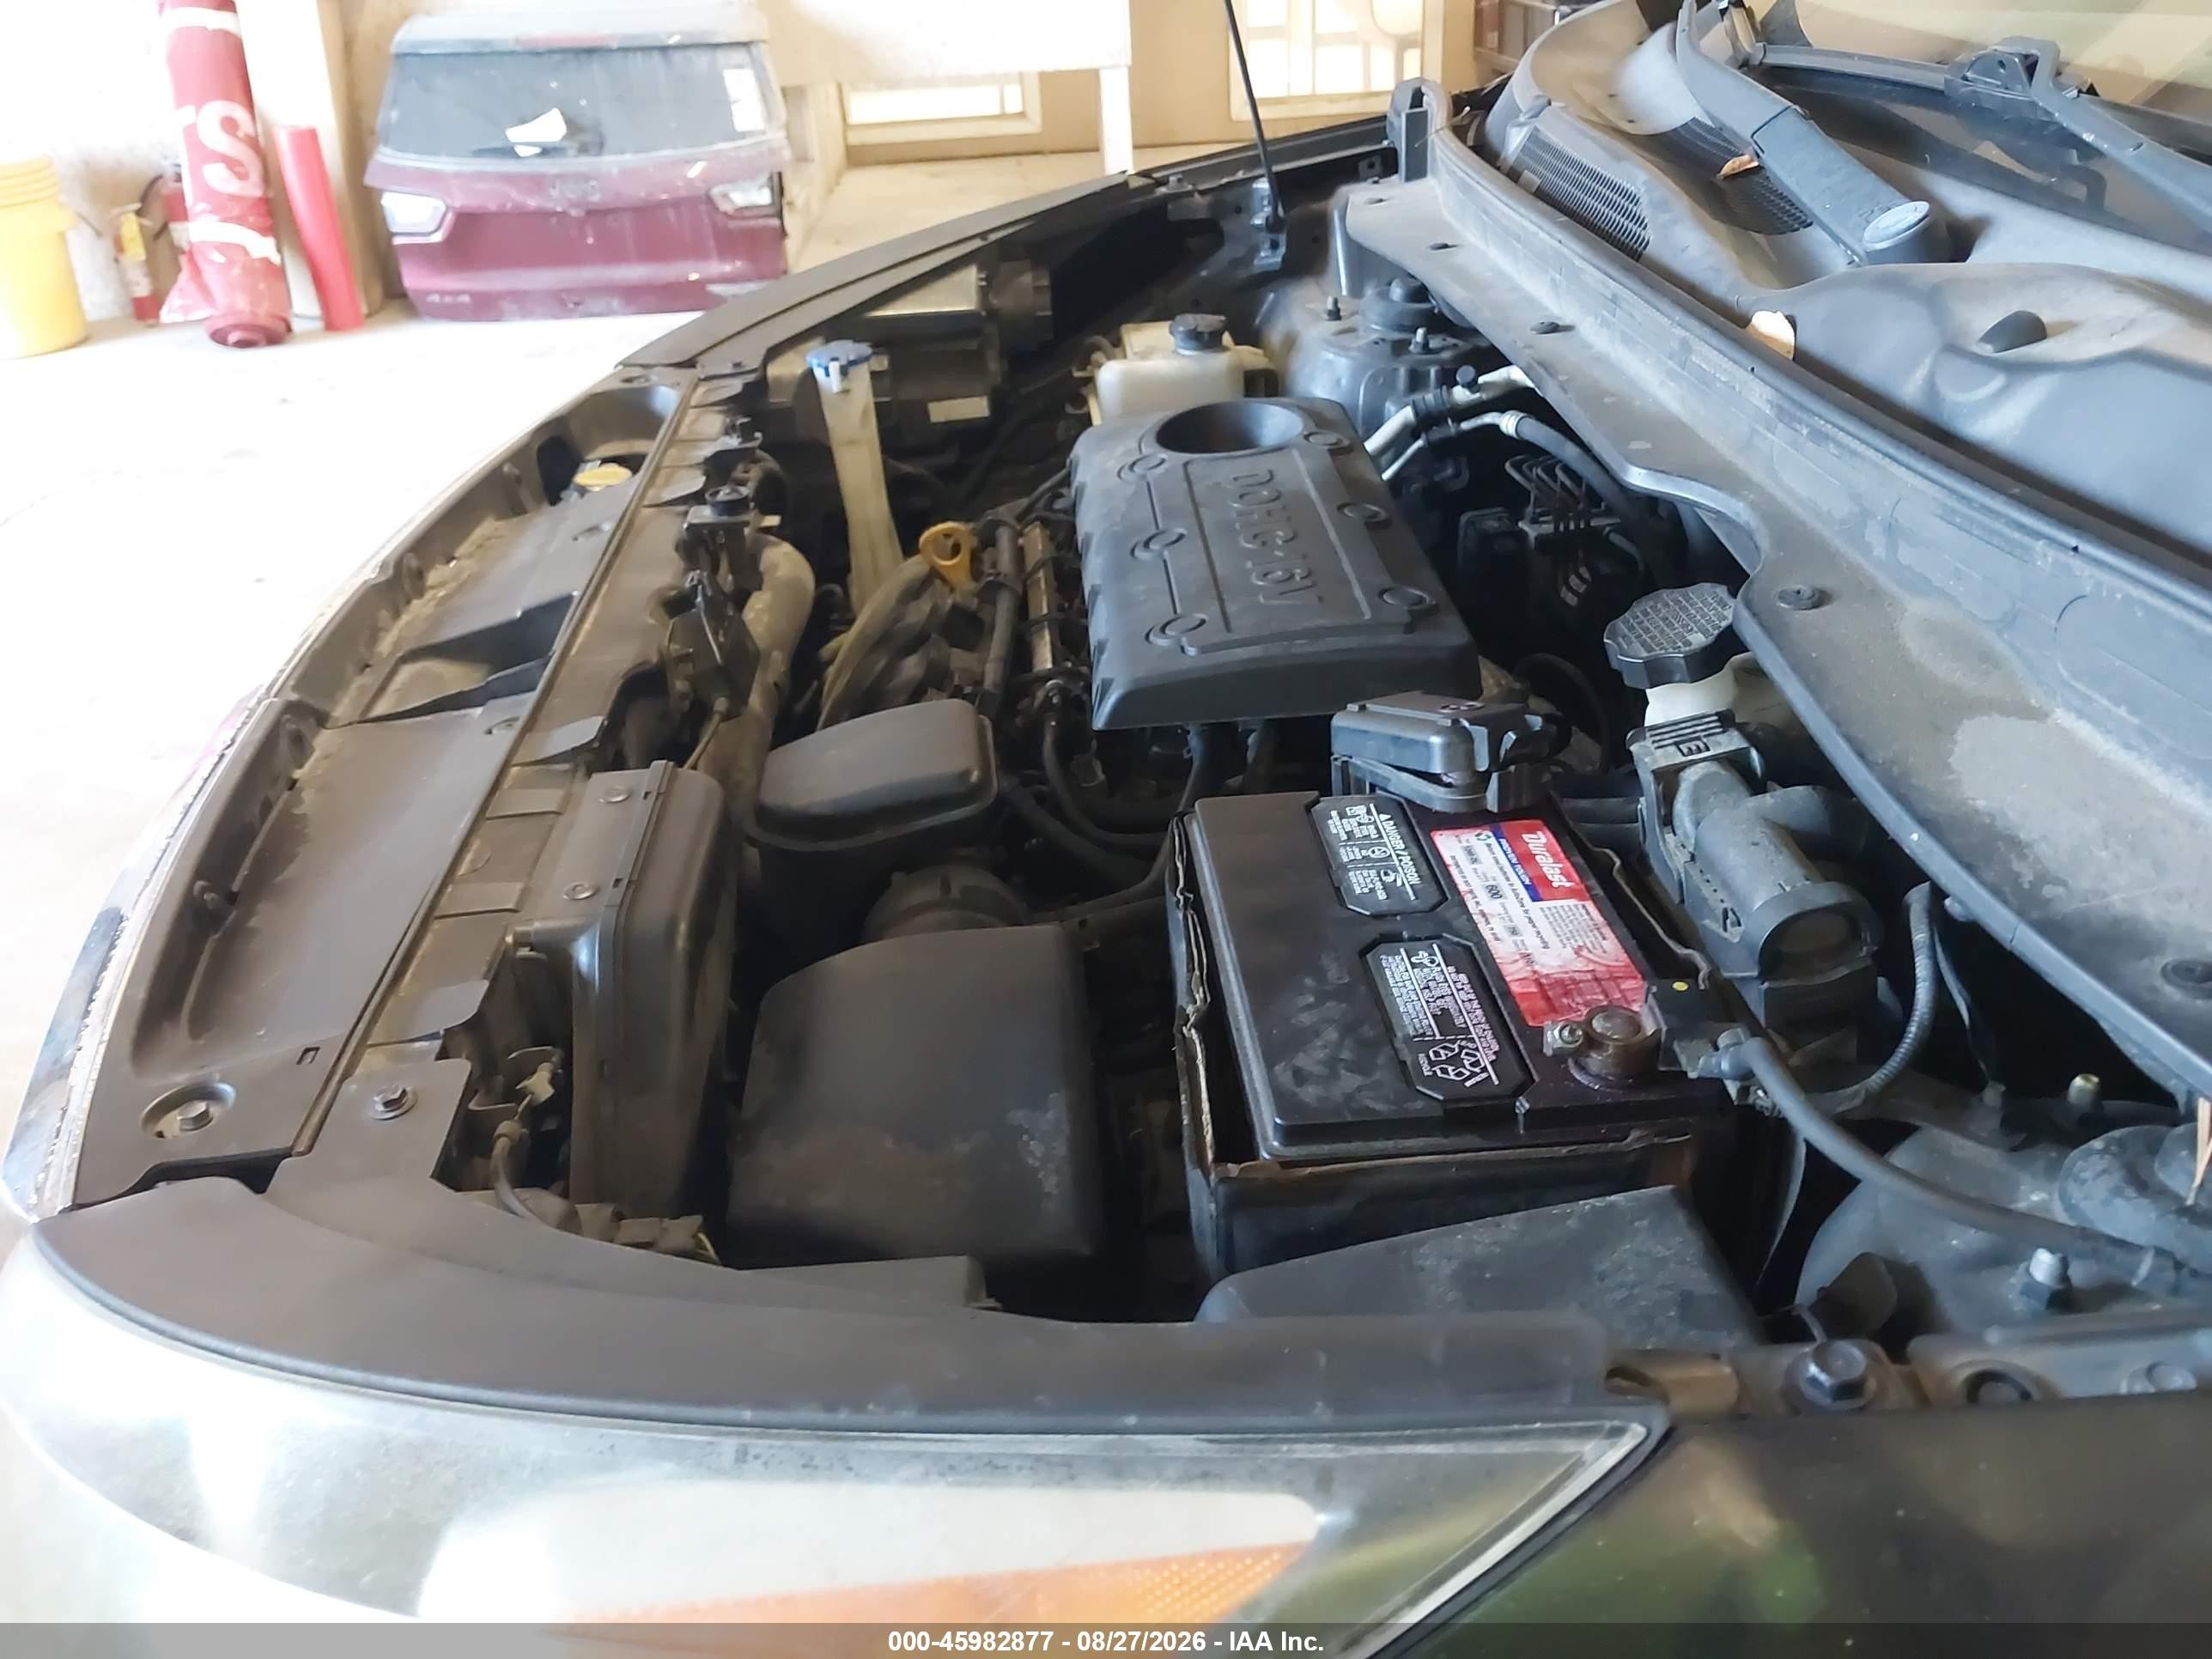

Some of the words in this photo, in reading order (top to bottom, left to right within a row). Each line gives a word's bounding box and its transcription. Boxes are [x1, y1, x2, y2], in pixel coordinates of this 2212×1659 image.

[1382, 821, 1405, 849] DANGER
[1399, 856, 1422, 884] POISON
[1522, 830, 1575, 889] Duralast
[1486, 884, 1503, 899] 600
